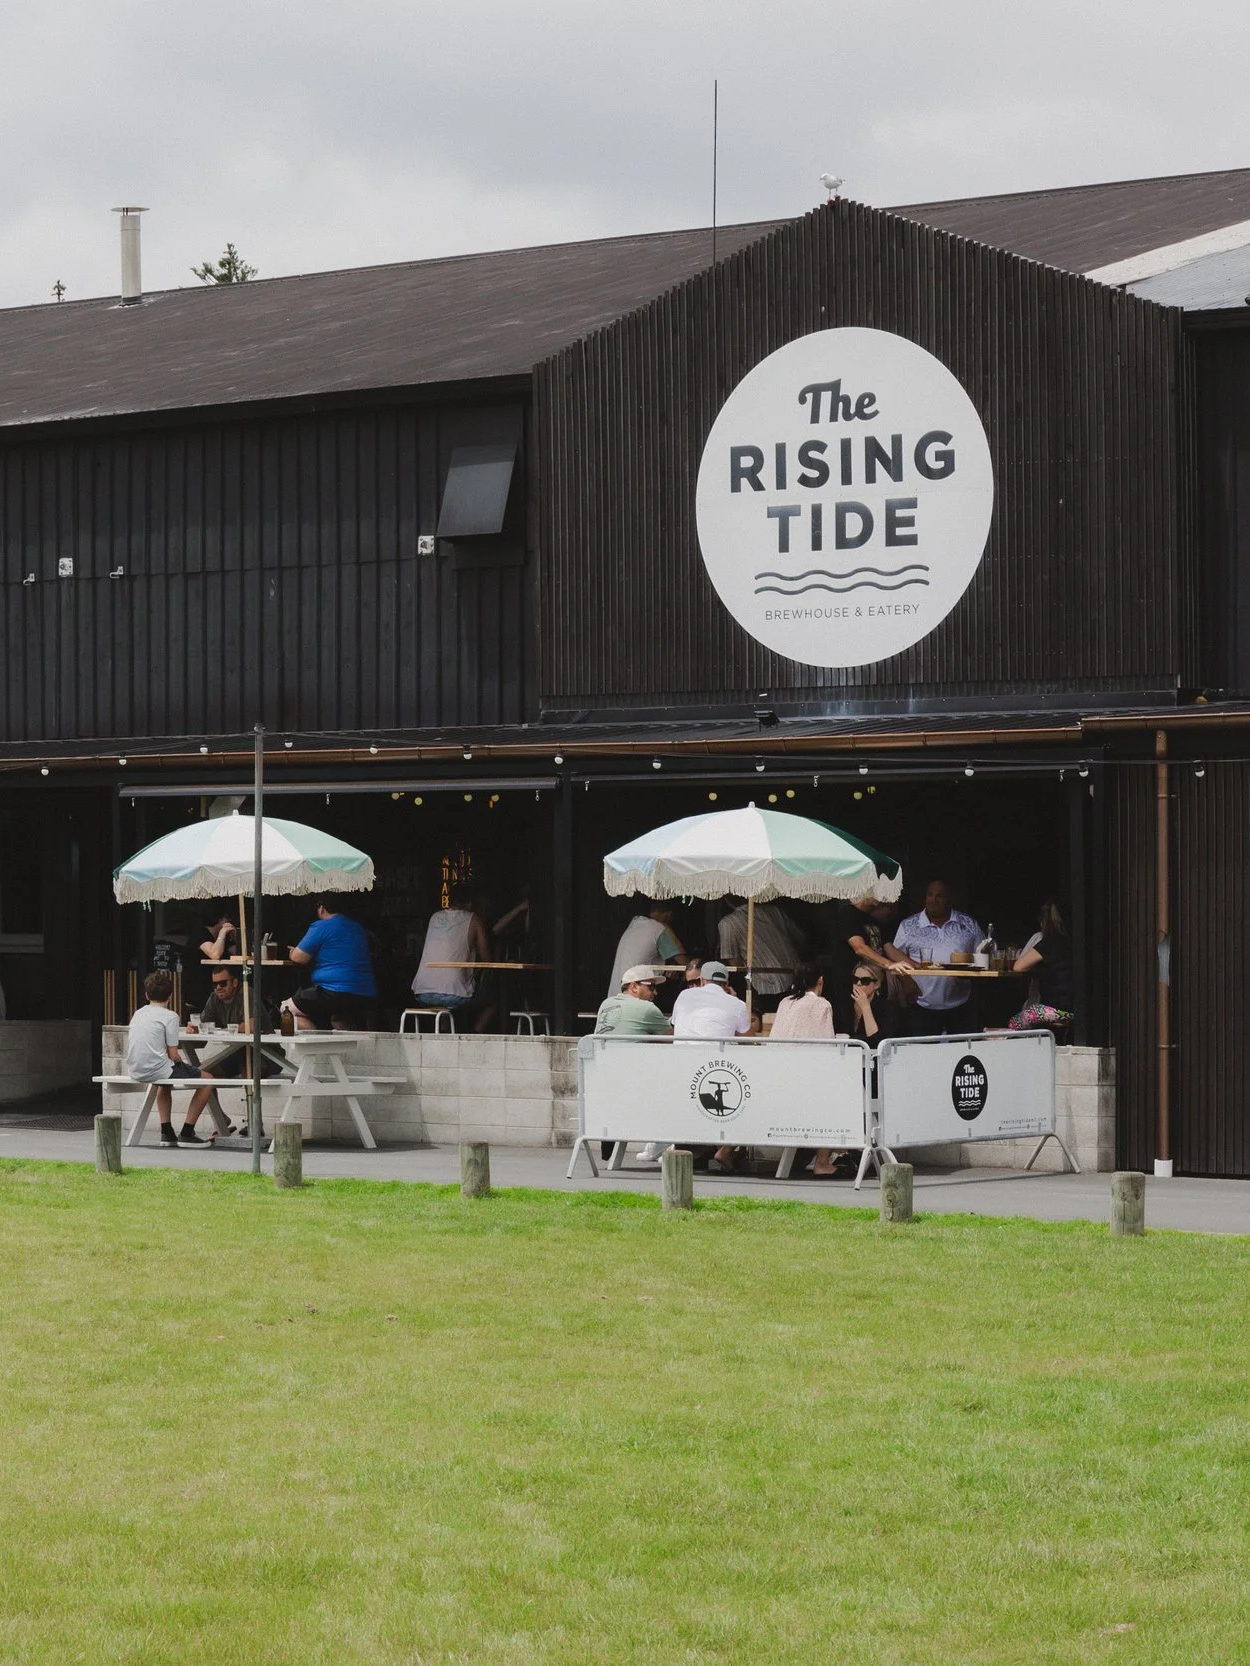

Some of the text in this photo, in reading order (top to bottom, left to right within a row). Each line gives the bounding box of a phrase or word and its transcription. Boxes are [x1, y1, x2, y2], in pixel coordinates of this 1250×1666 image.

[797, 378, 880, 425] The
[729, 430, 956, 493] RISING
[766, 497, 918, 554] TIDE
[765, 604, 920, 621] BREWHOUSE & EATERY
[690, 1065, 707, 1099] MOUNT
[708, 1060, 748, 1082] BREWING
[955, 1074, 984, 1087] RISING
[963, 1064, 975, 1073] The
[960, 1087, 980, 1098] TIDE
